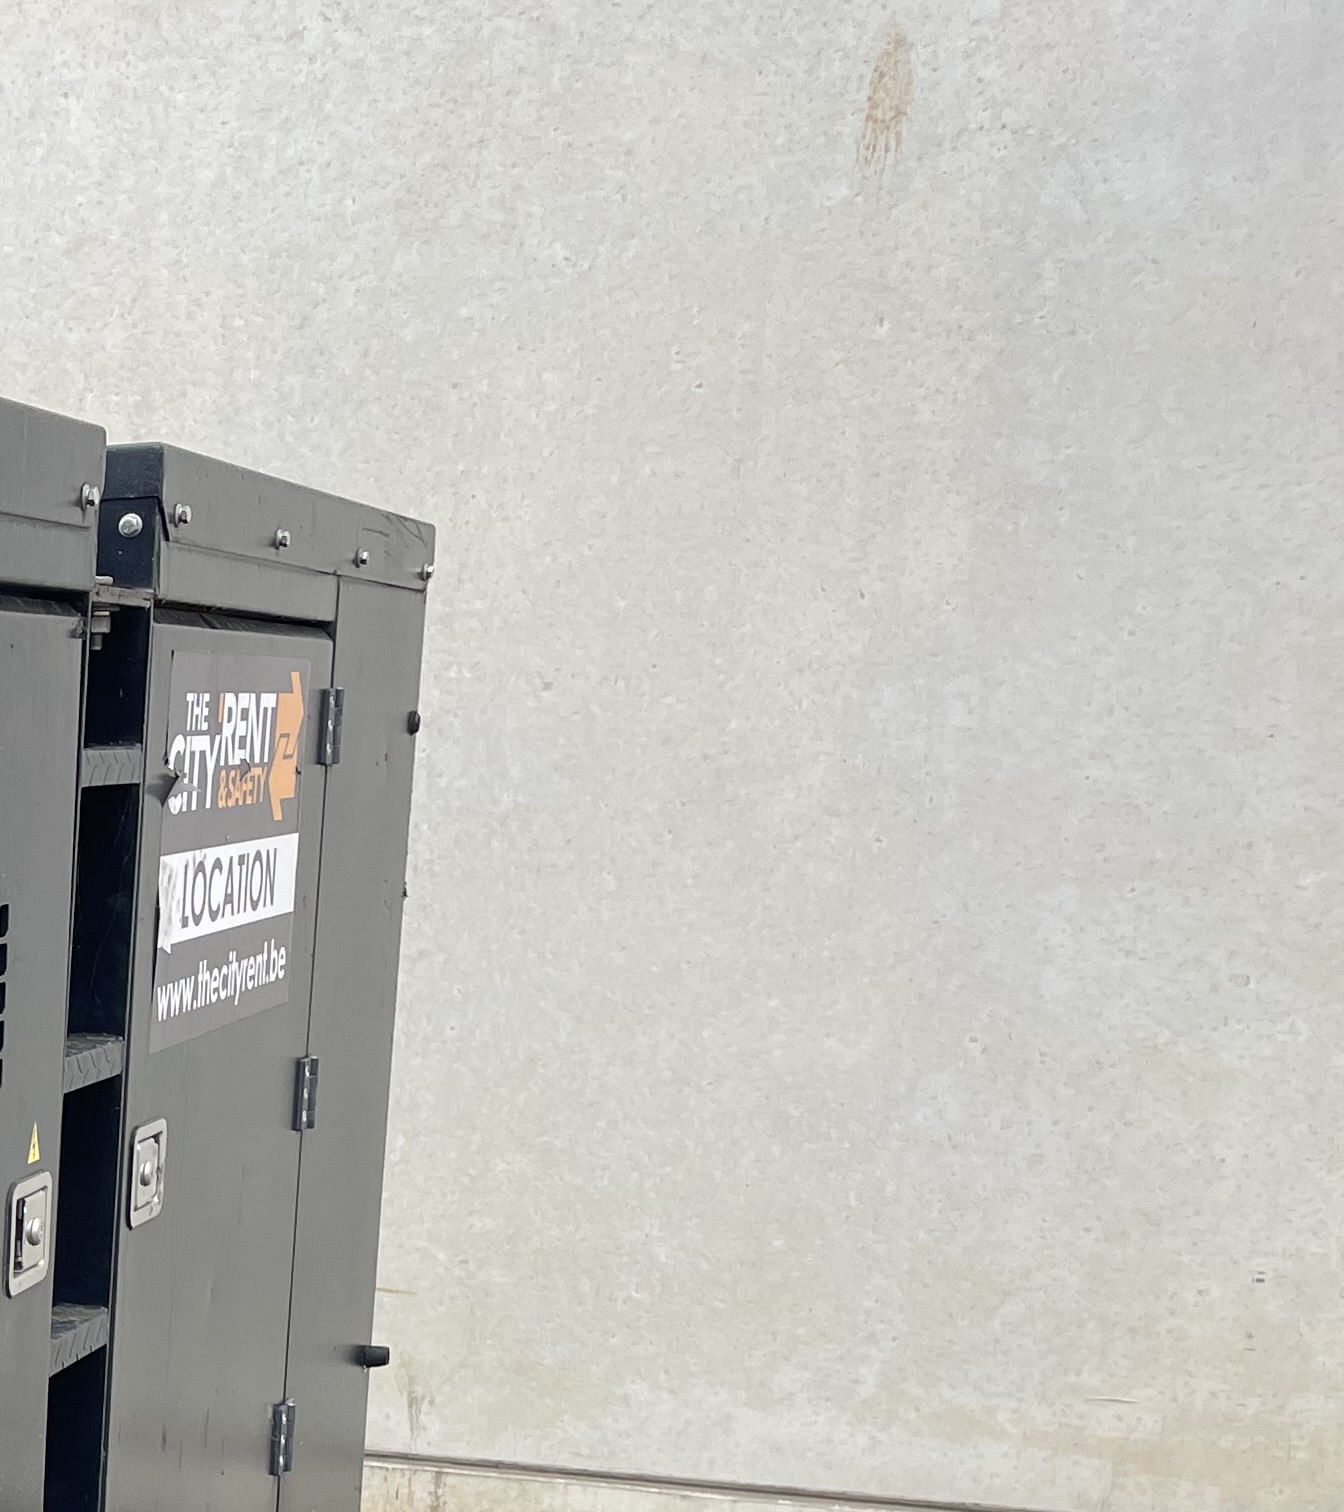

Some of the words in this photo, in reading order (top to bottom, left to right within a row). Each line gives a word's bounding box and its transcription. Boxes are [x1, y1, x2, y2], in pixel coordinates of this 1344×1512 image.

[186, 692, 211, 731] THE
[227, 766, 268, 808] SAFETY
[181, 847, 278, 930] LOCATION
[156, 937, 286, 1023] www.thecityrent.be
